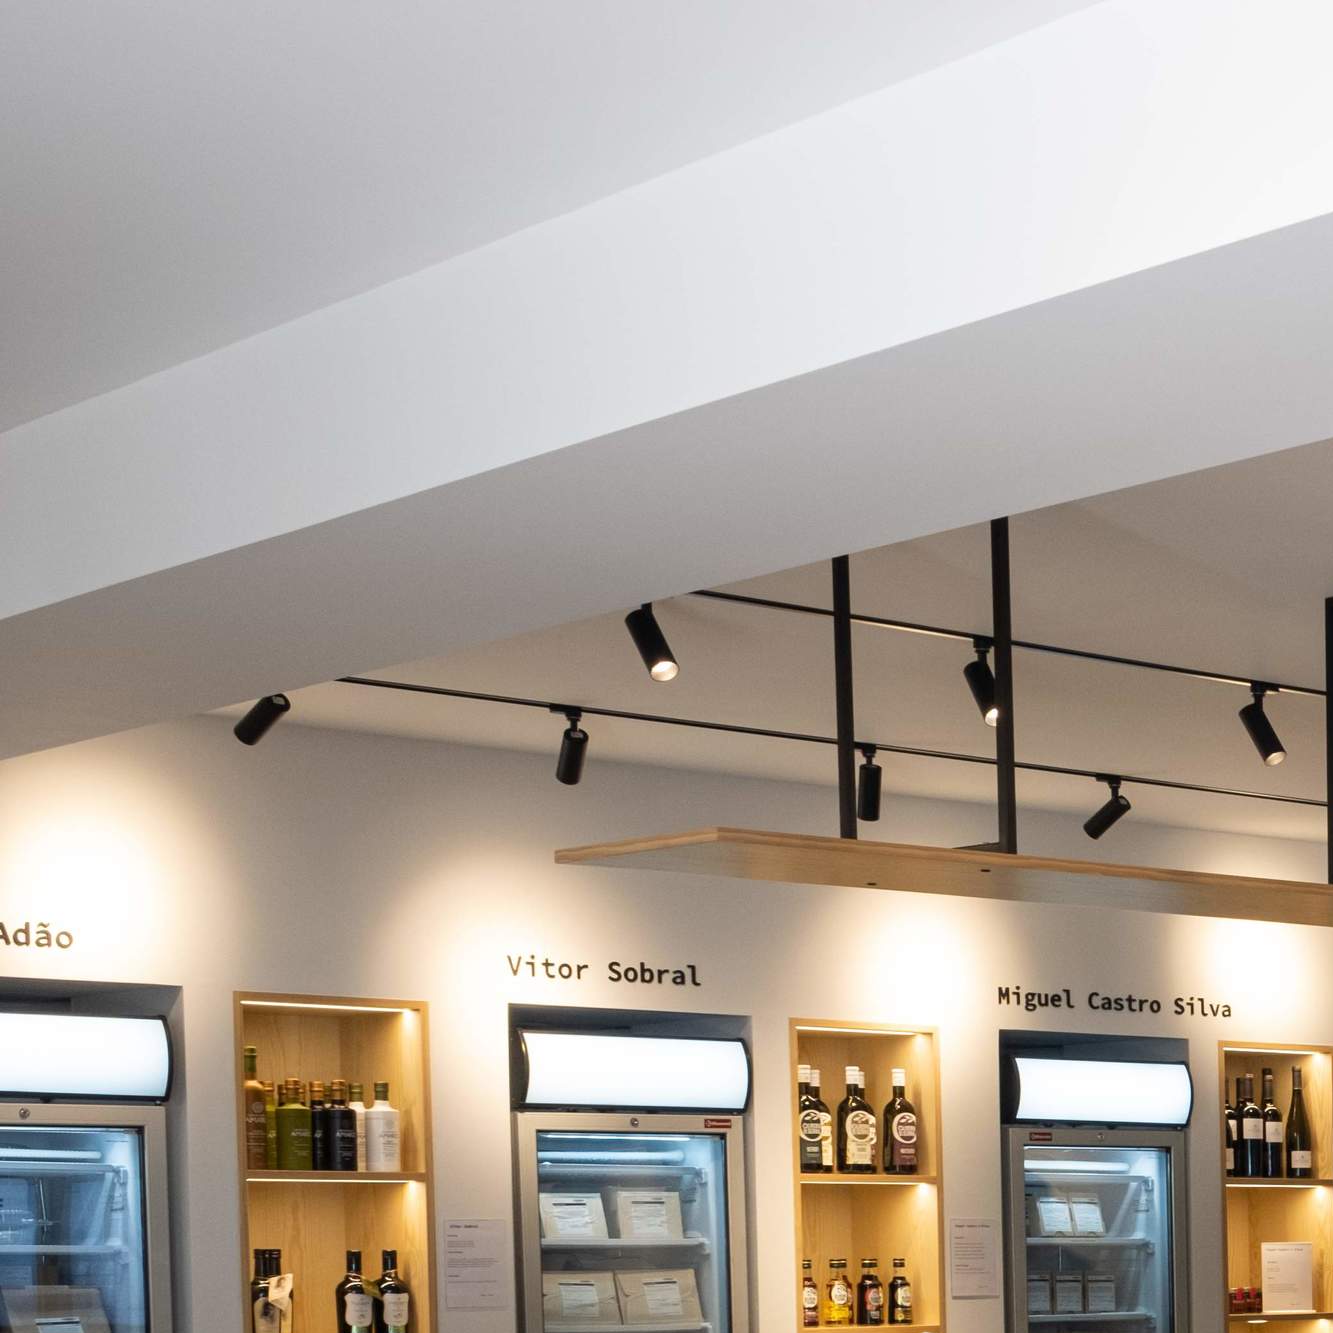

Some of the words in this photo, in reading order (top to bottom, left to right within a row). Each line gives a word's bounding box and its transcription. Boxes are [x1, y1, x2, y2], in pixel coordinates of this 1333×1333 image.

[506, 954, 589, 980] Vitor
[607, 961, 702, 987] Sobral
[998, 985, 1075, 1012] Miguel
[1088, 992, 1162, 1014] Castro
[1173, 997, 1232, 1018] Silva
